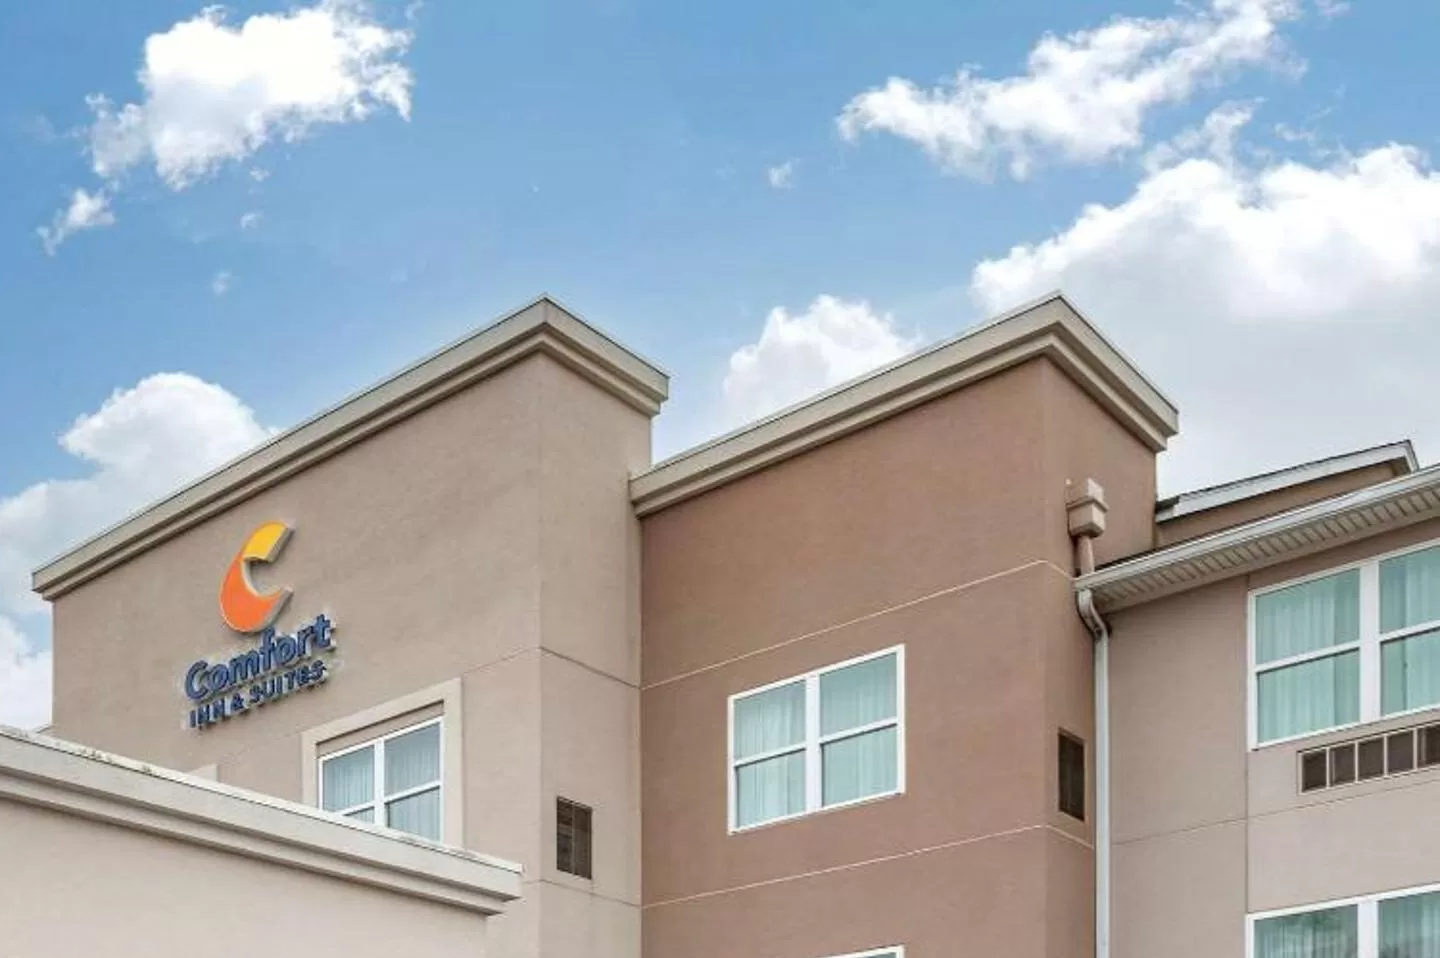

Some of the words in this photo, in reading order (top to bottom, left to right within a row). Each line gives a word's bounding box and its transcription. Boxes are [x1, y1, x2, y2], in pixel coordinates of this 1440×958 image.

[185, 613, 332, 700] Comfort
[189, 698, 226, 728] INN
[231, 692, 245, 711] &
[249, 659, 327, 704] SUITES
